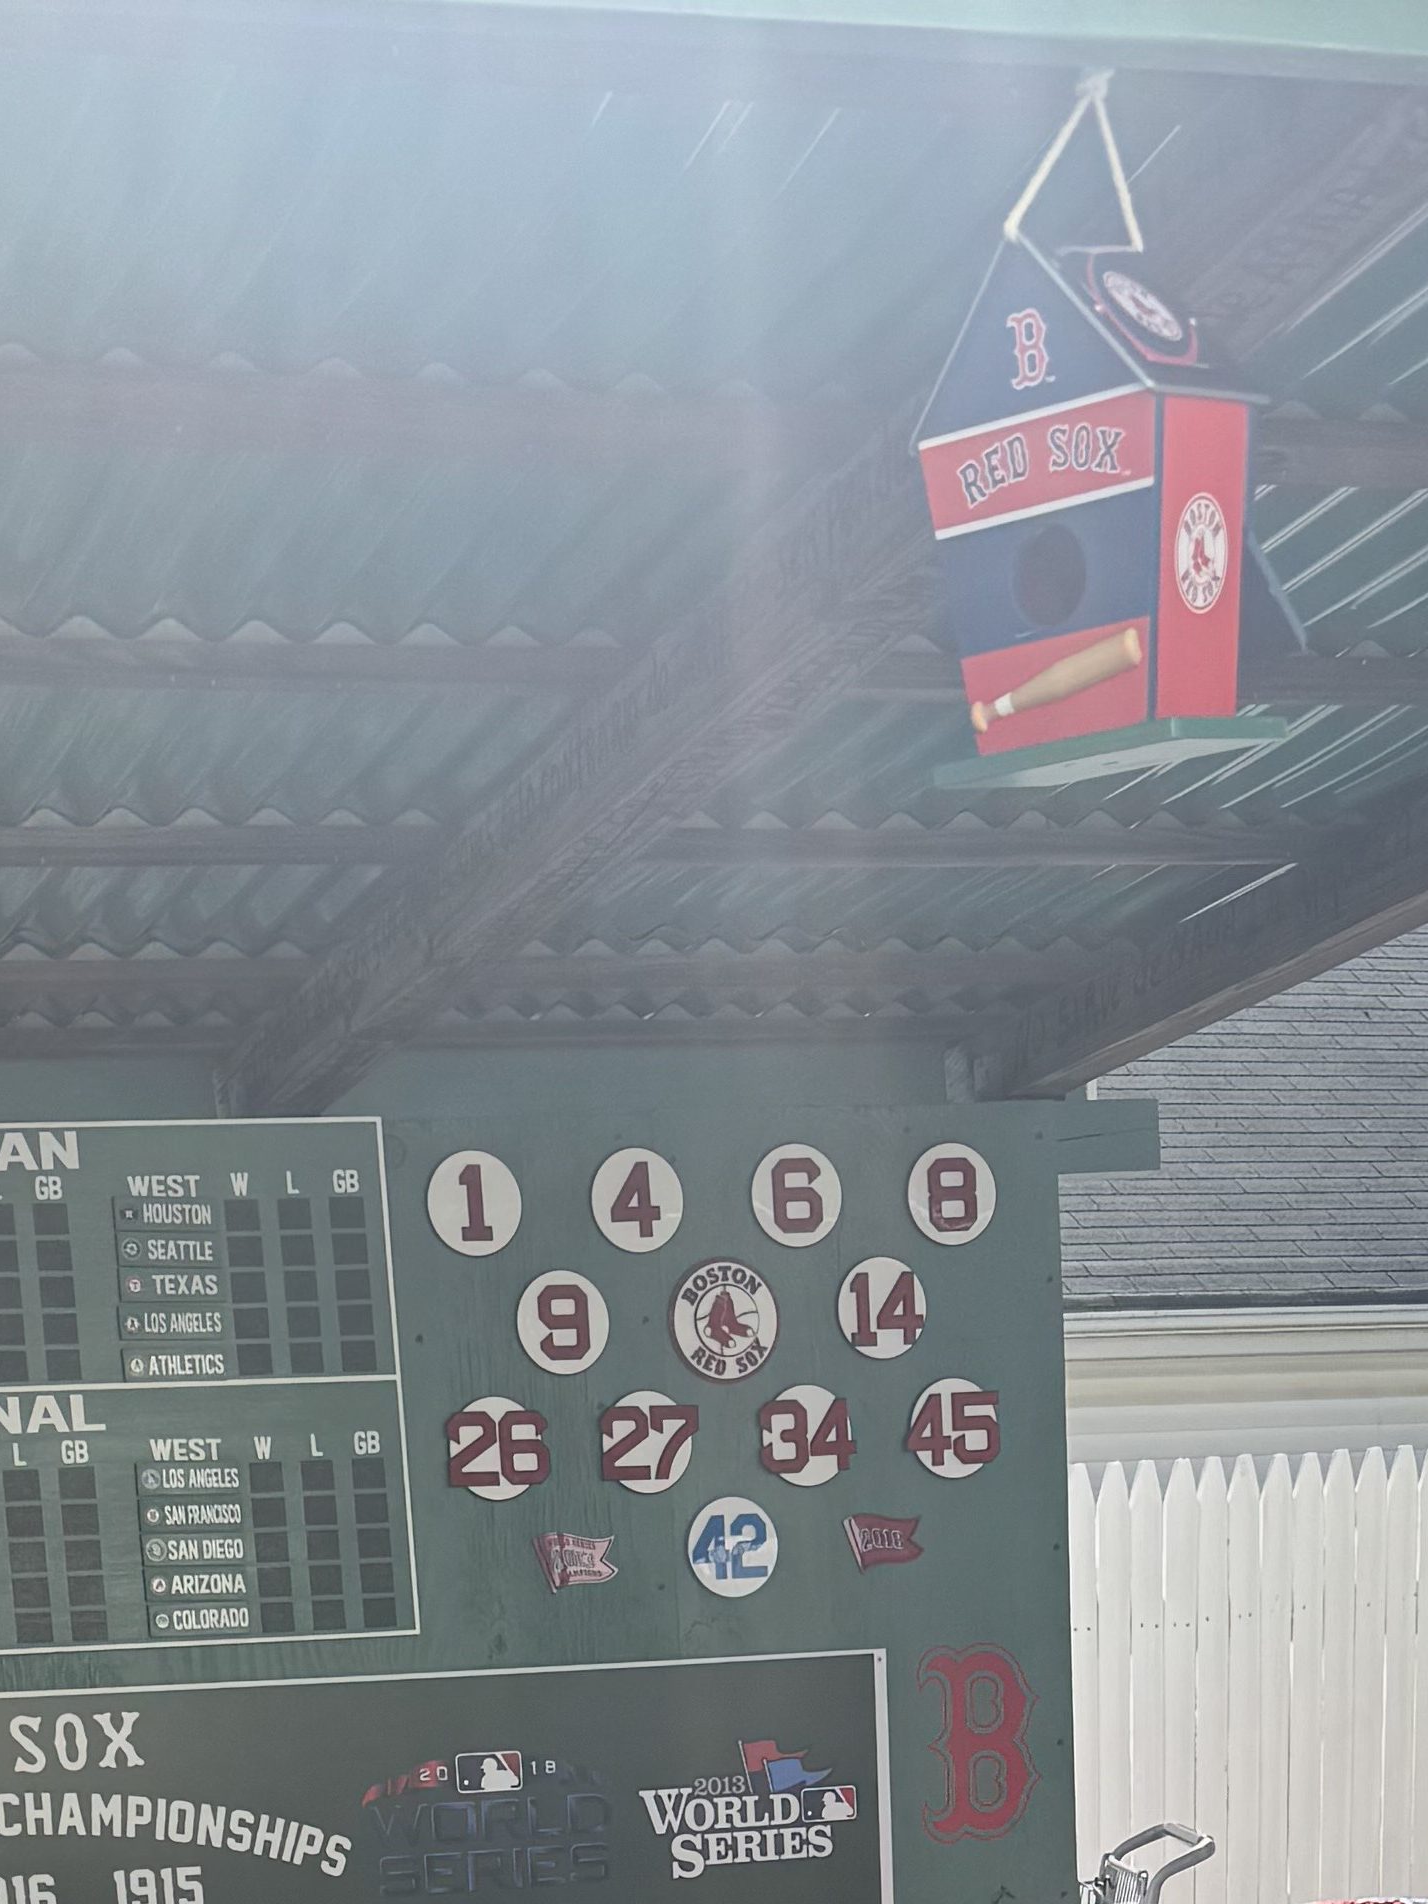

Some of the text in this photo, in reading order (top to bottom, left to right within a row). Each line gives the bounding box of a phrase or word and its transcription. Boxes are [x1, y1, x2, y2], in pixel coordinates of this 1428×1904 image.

[1006, 308, 1049, 390] B
[957, 422, 1126, 509] RED SOX
[34, 1175, 63, 1200] GB
[126, 1169, 360, 1197] WEST W L GB
[458, 1164, 494, 1242] 1
[610, 1161, 661, 1238] 4
[771, 1157, 824, 1234] 6
[927, 1157, 978, 1232] 8
[142, 1203, 212, 1225] HOUSTON
[147, 1239, 213, 1261] SEATTLE
[151, 1274, 219, 1296] TEXAS
[681, 1265, 762, 1307] BOSTON
[144, 1312, 222, 1334] LOS ANGELES
[536, 1284, 591, 1361] 9
[849, 1271, 924, 1348] 14
[148, 1354, 225, 1376] ATHLETICS
[690, 1336, 769, 1376] RED SOX
[149, 1430, 381, 1462] WEST W L GB
[445, 1410, 552, 1488] 26
[599, 1405, 699, 1482] 27
[759, 1397, 857, 1474] 34
[906, 1391, 1001, 1466] 45
[12, 1442, 28, 1467] L
[60, 1440, 90, 1465] GB
[162, 1467, 239, 1489] LOS ANGELES
[164, 1504, 241, 1526] SAN FRANCISCO
[168, 1538, 244, 1561] SAN DIEGO
[691, 1513, 768, 1581] 42
[171, 1573, 247, 1595] ARIZONA
[172, 1607, 249, 1631] COLORADO
[9, 1711, 146, 1775] SOX
[915, 1641, 1044, 1845] B
[693, 1775, 746, 1797] 2013
[638, 1788, 801, 1837] WORLD
[671, 1824, 833, 1880] SERIES
